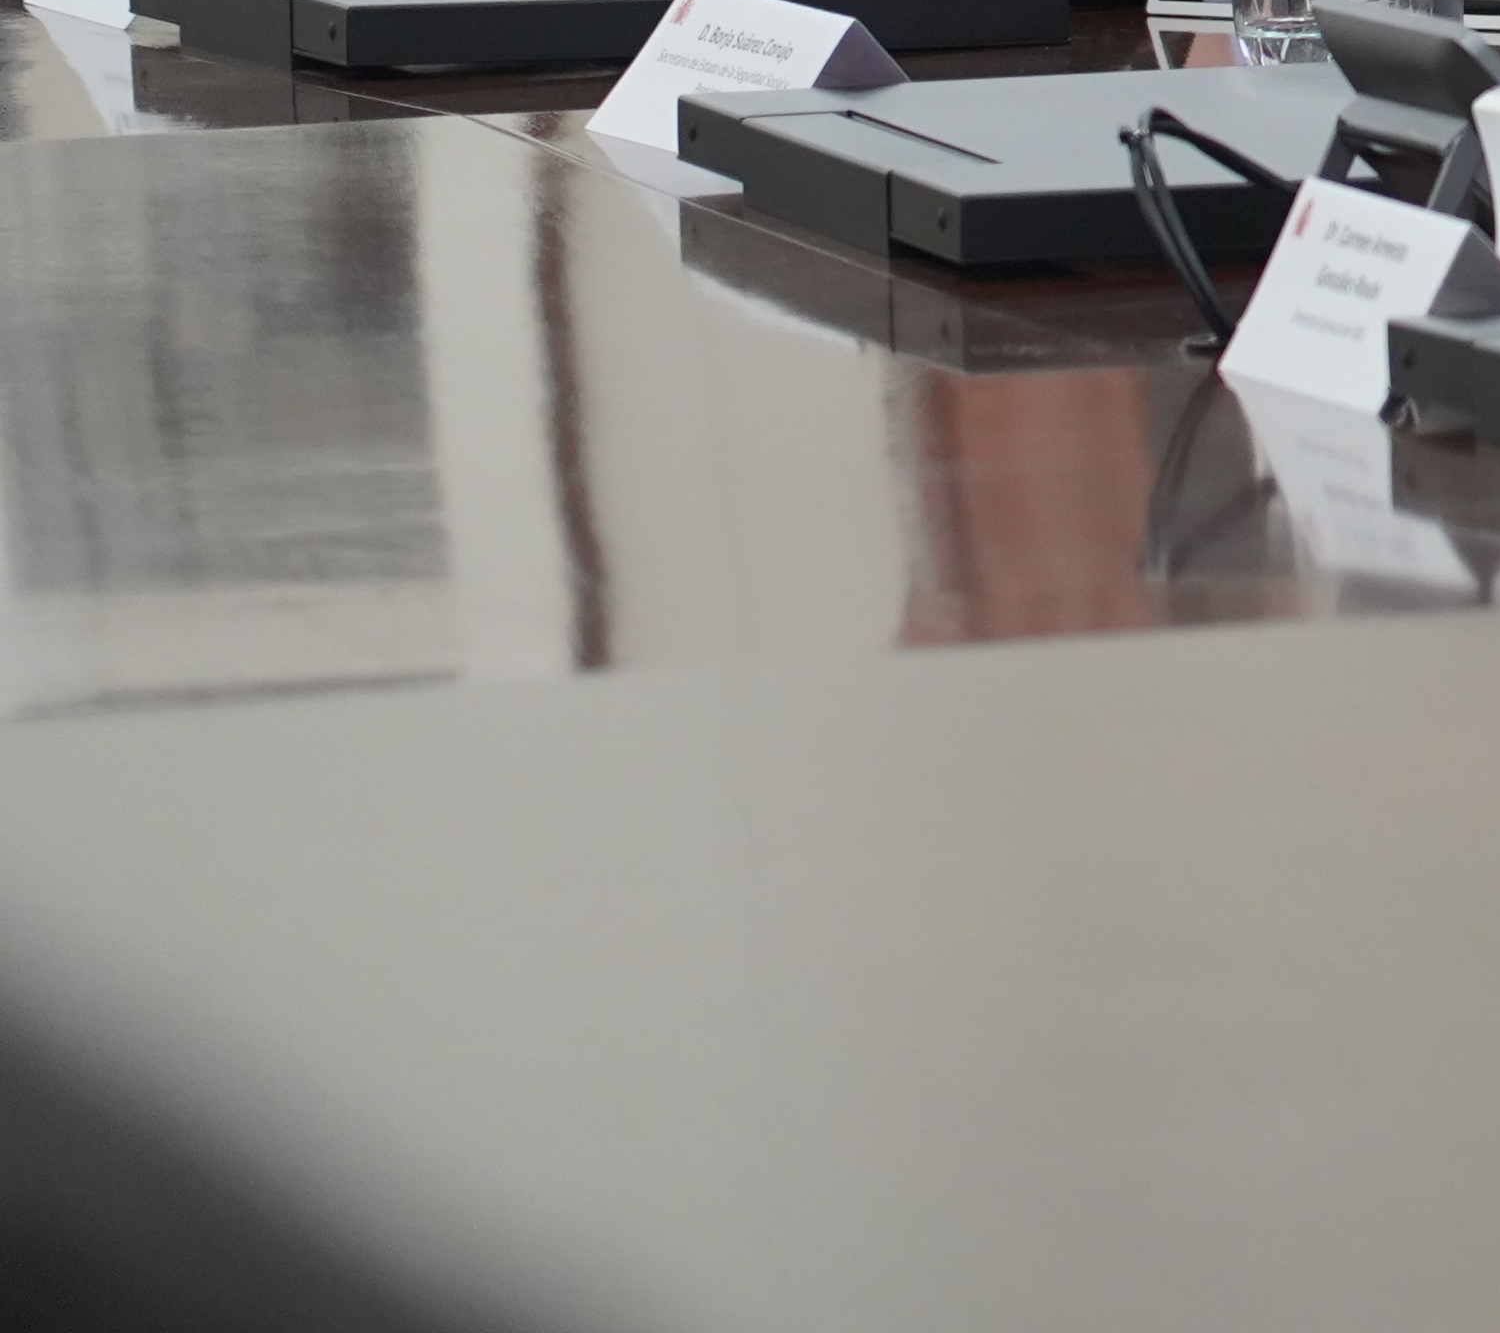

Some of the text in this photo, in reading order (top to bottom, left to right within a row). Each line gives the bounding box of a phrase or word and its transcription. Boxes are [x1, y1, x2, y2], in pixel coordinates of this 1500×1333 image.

[698, 24, 793, 64] D. Borja Suárez Corujo
[696, 58, 721, 76] Estado
[733, 66, 768, 85] Seguridad
